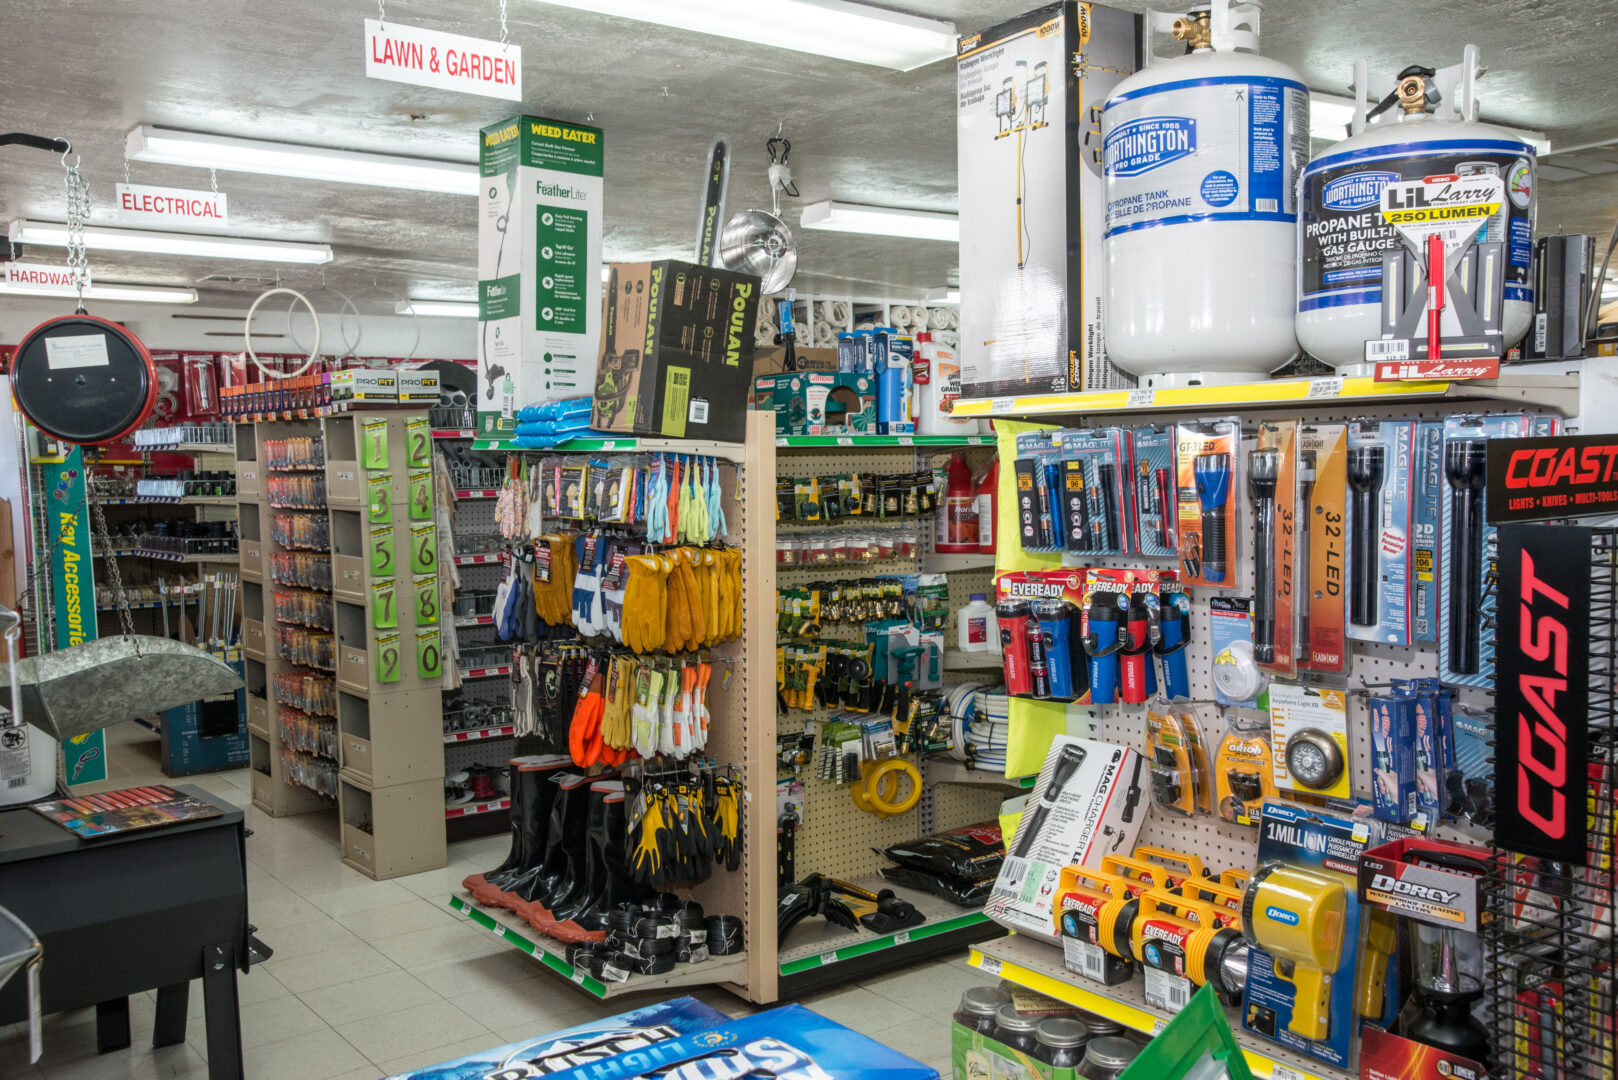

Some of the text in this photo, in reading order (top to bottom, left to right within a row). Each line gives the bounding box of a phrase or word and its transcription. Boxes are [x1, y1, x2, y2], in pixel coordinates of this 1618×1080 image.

[1039, 21, 1061, 35] 1000W
[372, 35, 515, 86] LAWN & GARDEN
[980, 48, 1005, 62] Worklight
[531, 122, 596, 145] WEED EATER
[1139, 123, 1160, 132] SINCE
[1104, 129, 1188, 169] WORTHINGTON
[1115, 153, 1160, 170] PRO GRADE
[536, 180, 587, 201] FeatherLite
[1113, 189, 1169, 208] PROPANE TANK
[1326, 180, 1392, 204] WORTHINGTO
[1388, 184, 1496, 210] LiL Larry
[121, 193, 223, 219] ELECTRICAL
[1133, 204, 1144, 214] DE
[1146, 197, 1192, 212] PROPANE
[1391, 211, 1426, 223] 250
[1429, 206, 1491, 219] LUMEN
[700, 205, 717, 267] POULAN
[1306, 213, 1372, 239] PROPANE
[1318, 232, 1347, 246] WITH
[1323, 238, 1395, 256] GAS GAUGE
[10, 269, 87, 287] HARDWA
[644, 266, 663, 355] POULAN
[726, 282, 752, 367] POULAN
[1069, 349, 1077, 384] POWER
[1381, 364, 1489, 379] LiL Larry
[808, 373, 834, 384] Gilmour
[412, 432, 426, 461] 2
[1072, 440, 1113, 449] MAGLITE
[1142, 439, 1169, 447] MAGLITE
[1179, 441, 1215, 452] GT-3 LED
[1300, 440, 1324, 449] LASHLIGHT
[1397, 425, 1409, 500] MAGLITE
[1505, 445, 1618, 489] COAST
[1425, 445, 1440, 517] MAGLITE
[373, 487, 389, 517] 3
[414, 484, 429, 514] 4
[1508, 490, 1618, 510] LIGHTS KNIVES MULTI-TOOLS
[59, 511, 79, 547] Key
[1382, 531, 1406, 543] Powerful
[375, 538, 391, 570] 5
[417, 536, 434, 567] 6
[1282, 509, 1293, 596] 32-LED
[1325, 511, 1342, 597] 32-LED
[1381, 538, 1404, 550] Focusing
[1011, 582, 1065, 598] EVEREADY
[1087, 582, 1129, 594] EVEREADY
[377, 590, 394, 622] 7
[419, 588, 435, 618] 8
[382, 647, 399, 678] 9
[422, 643, 439, 672] 0
[1127, 661, 1135, 689] EVEREADY
[1271, 697, 1310, 708] Anywhere Light
[1517, 547, 1570, 840] COAST
[1271, 707, 1288, 780] LIGHT IT!
[1267, 806, 1296, 818] DORCY
[1364, 861, 1384, 870] LED
[1370, 873, 1460, 904] DORCY
[1063, 896, 1098, 916] EVEREADY
[1369, 891, 1461, 916] WATERPROOF FLOATING
[1395, 901, 1431, 914] LANTERN
[1267, 908, 1298, 923] DORCY
[1144, 924, 1184, 946] EVEREADY
[1453, 1064, 1476, 1080] LUMENS
